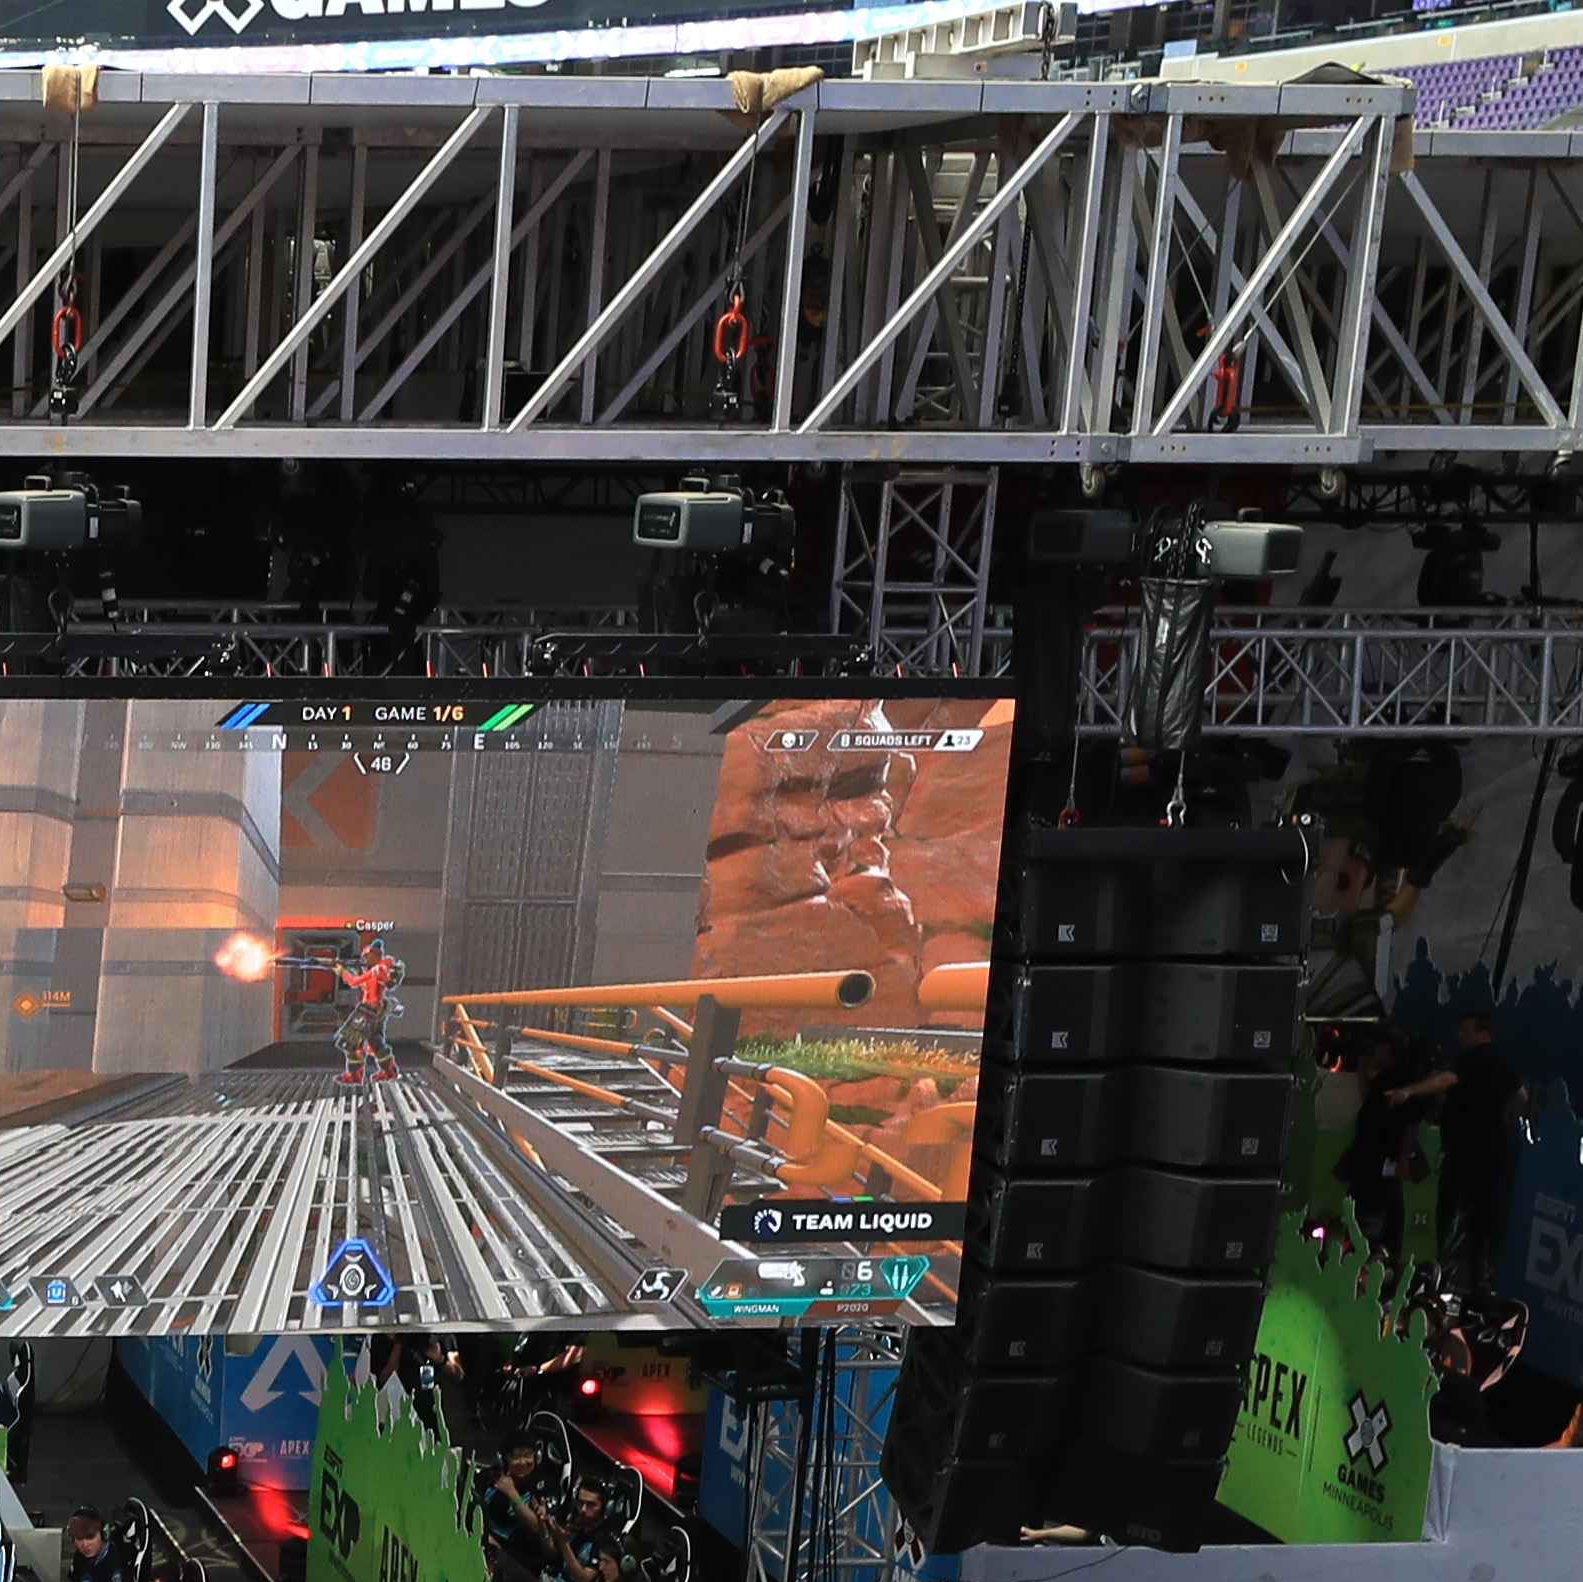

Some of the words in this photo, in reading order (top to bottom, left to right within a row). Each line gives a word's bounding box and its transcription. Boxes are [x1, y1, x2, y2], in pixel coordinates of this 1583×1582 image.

[302, 707, 336, 720] DAY
[342, 706, 351, 720] 1
[375, 706, 426, 721] GAME
[433, 706, 464, 721] 1/6
[272, 733, 288, 750] N
[474, 734, 485, 750] E
[855, 735, 903, 747] SQUADS
[905, 734, 932, 746] LEFT
[355, 919, 395, 932] Casper
[792, 1214, 853, 1231] TEAM
[860, 1213, 933, 1234] LIQUID
[733, 1304, 780, 1314] WINGMAN
[837, 1303, 869, 1313] P2020
[642, 1363, 671, 1379] APEX
[280, 1439, 311, 1456] APEX
[1246, 1422, 1284, 1457] LEGENDS
[1337, 1463, 1386, 1504] GAMES
[319, 1467, 361, 1562] EXP
[1322, 1481, 1394, 1532] MINNEAPOLIS
